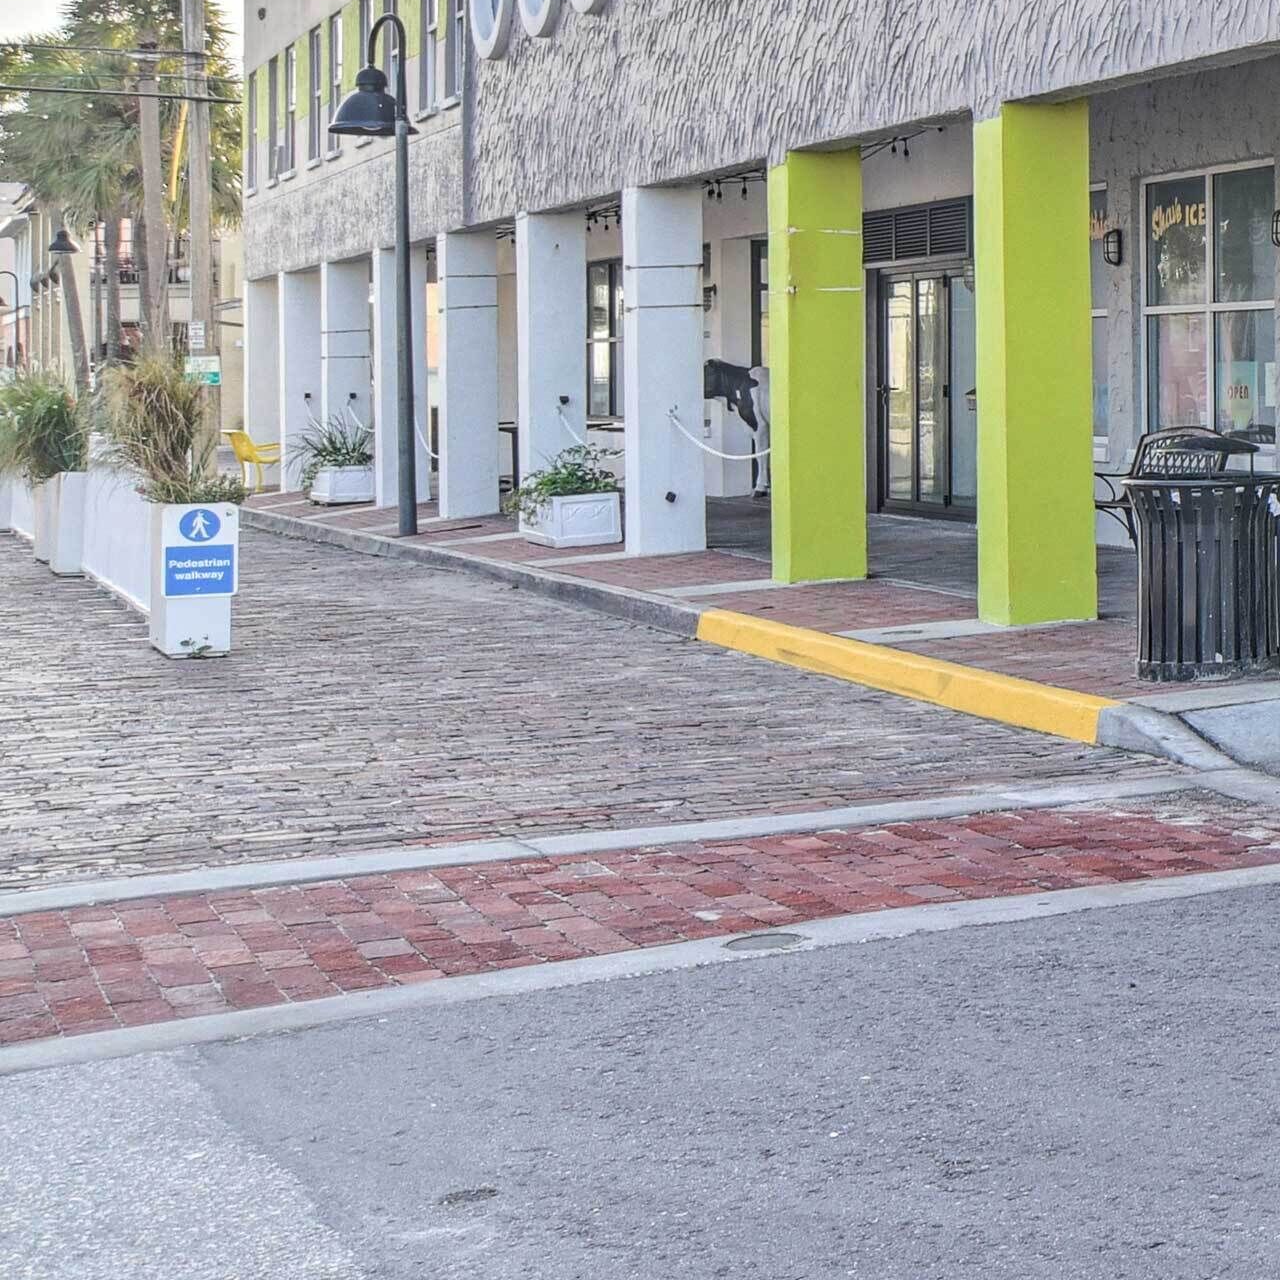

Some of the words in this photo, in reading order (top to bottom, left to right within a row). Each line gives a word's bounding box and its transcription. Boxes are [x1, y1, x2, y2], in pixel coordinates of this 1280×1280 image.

[1185, 202, 1206, 227] ICE
[1228, 385, 1250, 401] OPEN
[168, 557, 231, 569] Pedestrian
[174, 571, 224, 581] walkway
